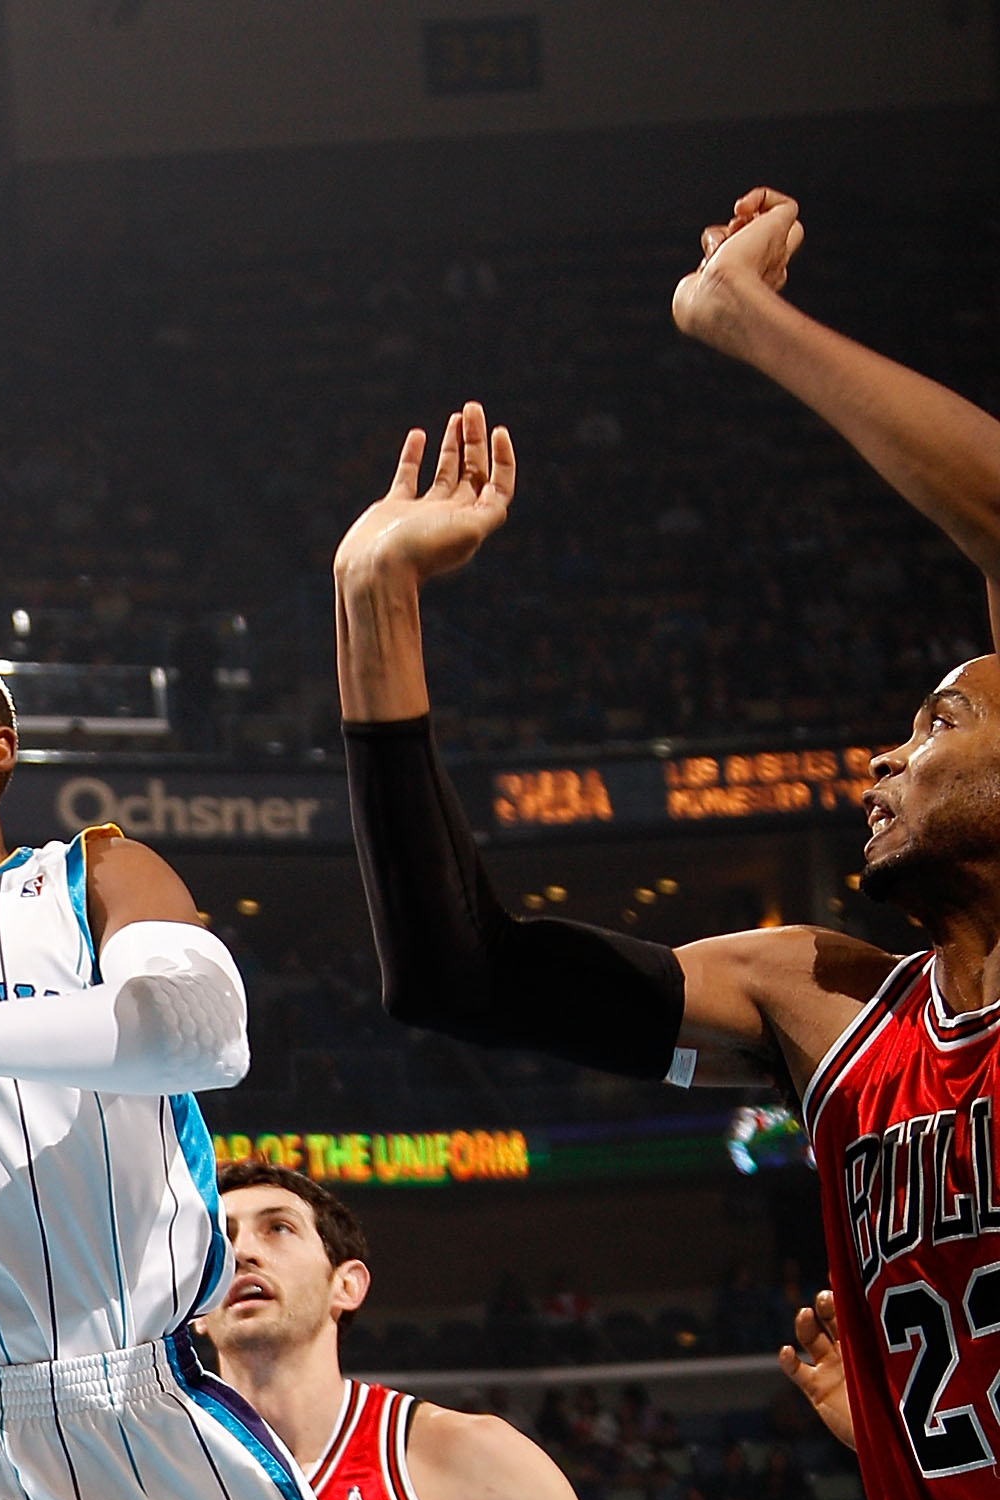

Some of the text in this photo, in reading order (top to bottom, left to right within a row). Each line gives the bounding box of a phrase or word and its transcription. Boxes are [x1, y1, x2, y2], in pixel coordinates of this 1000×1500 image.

[58, 776, 320, 836] Ochsner
[305, 1132, 371, 1182] THE
[372, 1129, 528, 1183] UNIFORM
